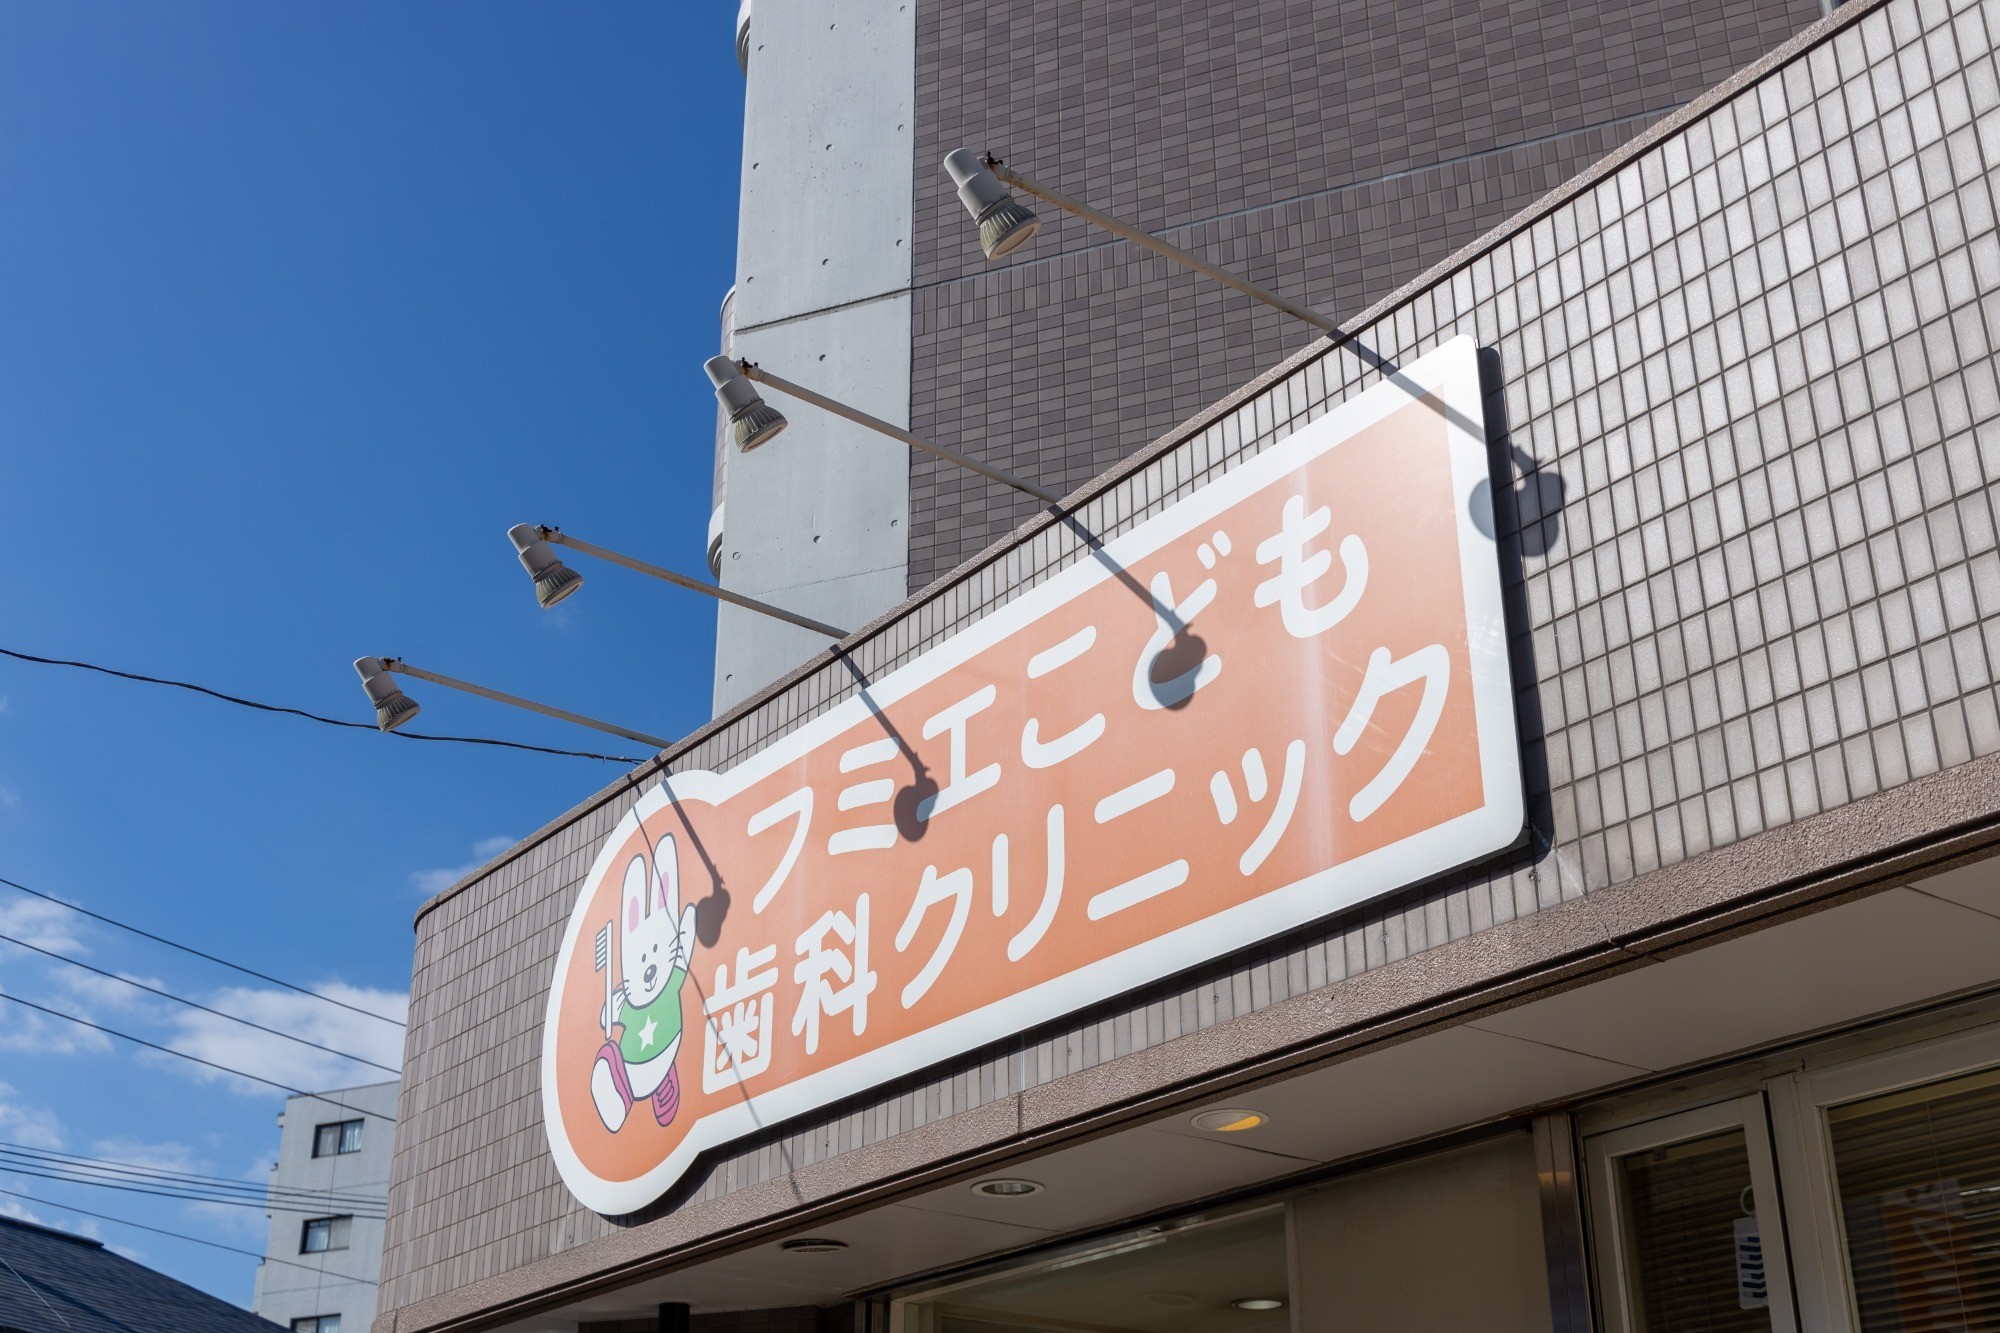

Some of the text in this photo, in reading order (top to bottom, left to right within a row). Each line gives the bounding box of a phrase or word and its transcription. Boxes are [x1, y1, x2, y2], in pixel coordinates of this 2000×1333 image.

[704, 643, 1450, 1094] 歯科クリニック
[747, 495, 1369, 914] フミエこども
